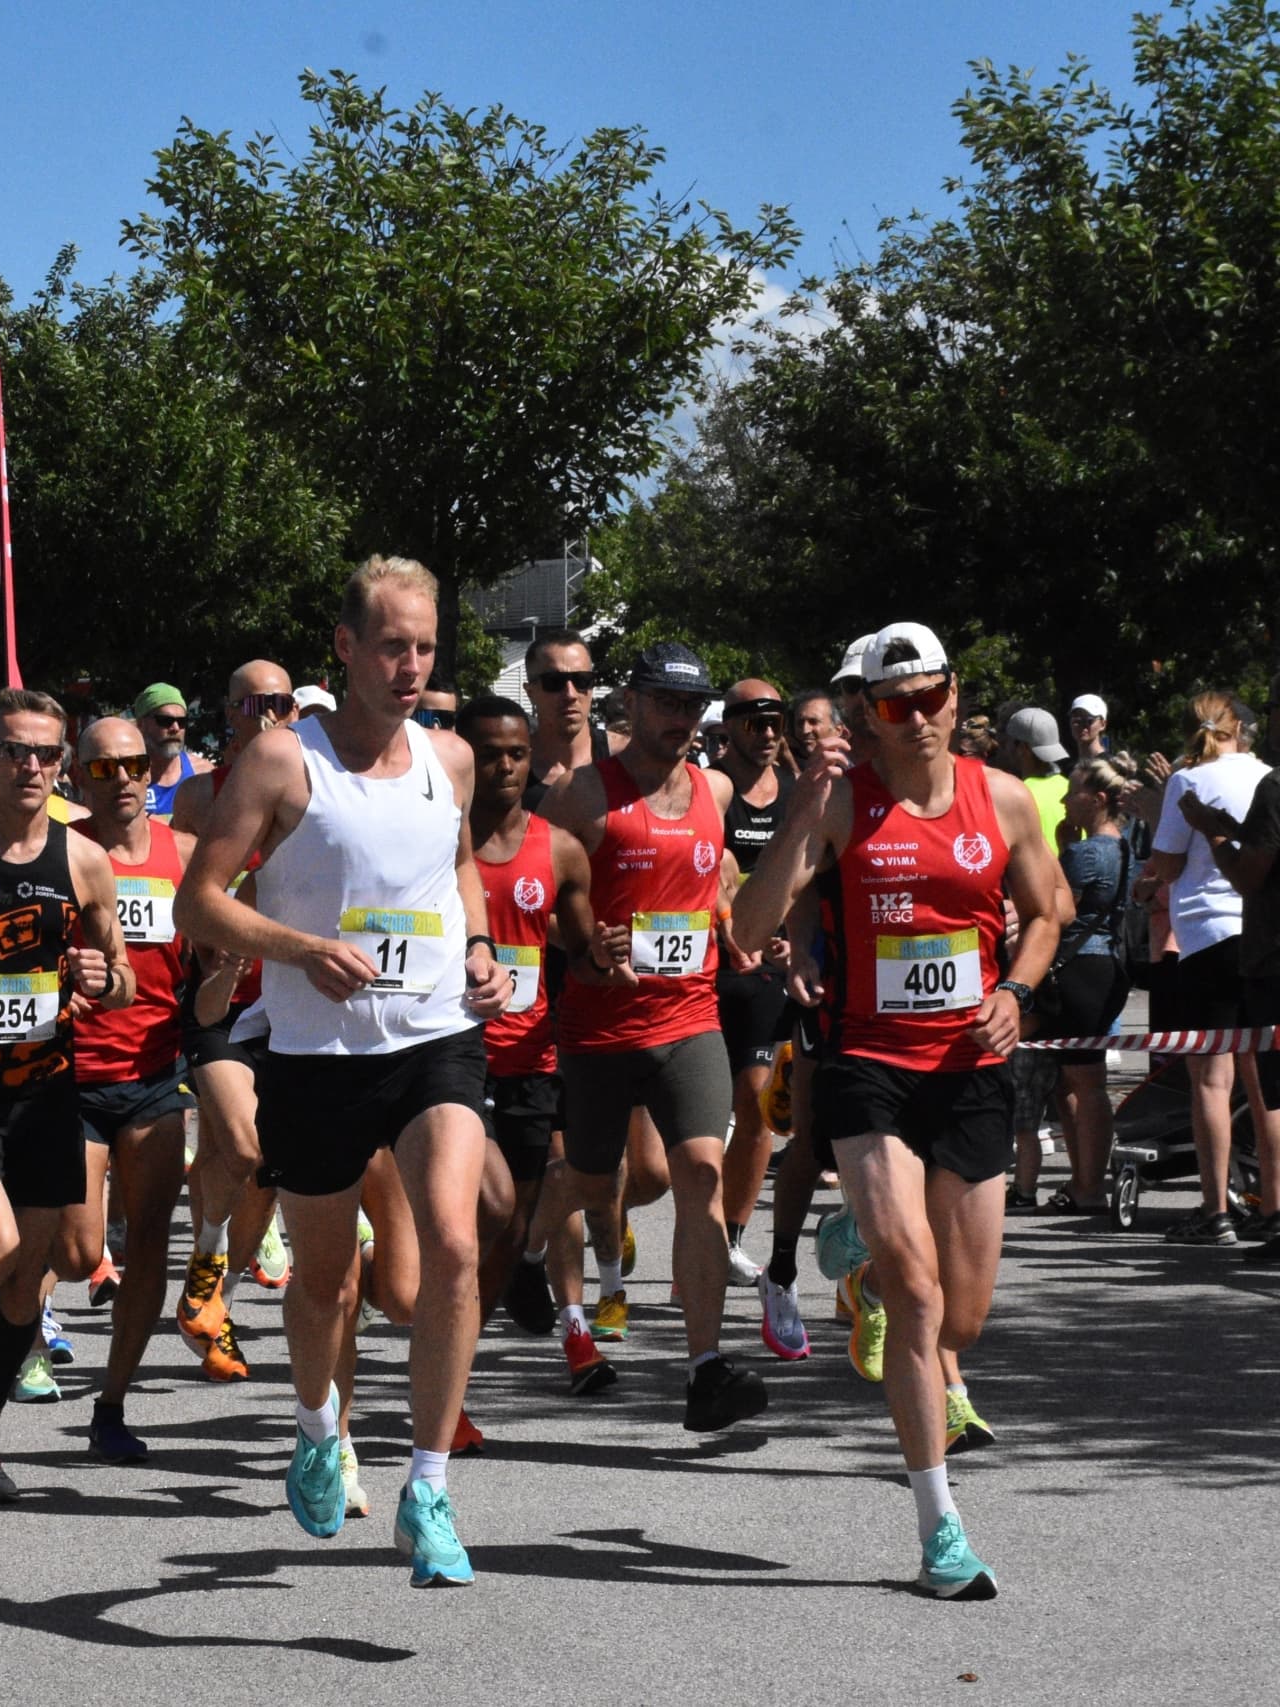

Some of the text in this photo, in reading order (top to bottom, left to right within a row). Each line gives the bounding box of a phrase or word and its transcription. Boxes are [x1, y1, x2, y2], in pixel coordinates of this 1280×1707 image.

[894, 842, 919, 851] SAND
[886, 856, 916, 866] VISMA
[117, 899, 153, 927] 261
[869, 892, 913, 911] 1X2
[871, 910, 913, 924] BYGG
[377, 938, 407, 974] 11
[655, 935, 692, 962] 125
[905, 961, 956, 995] 400
